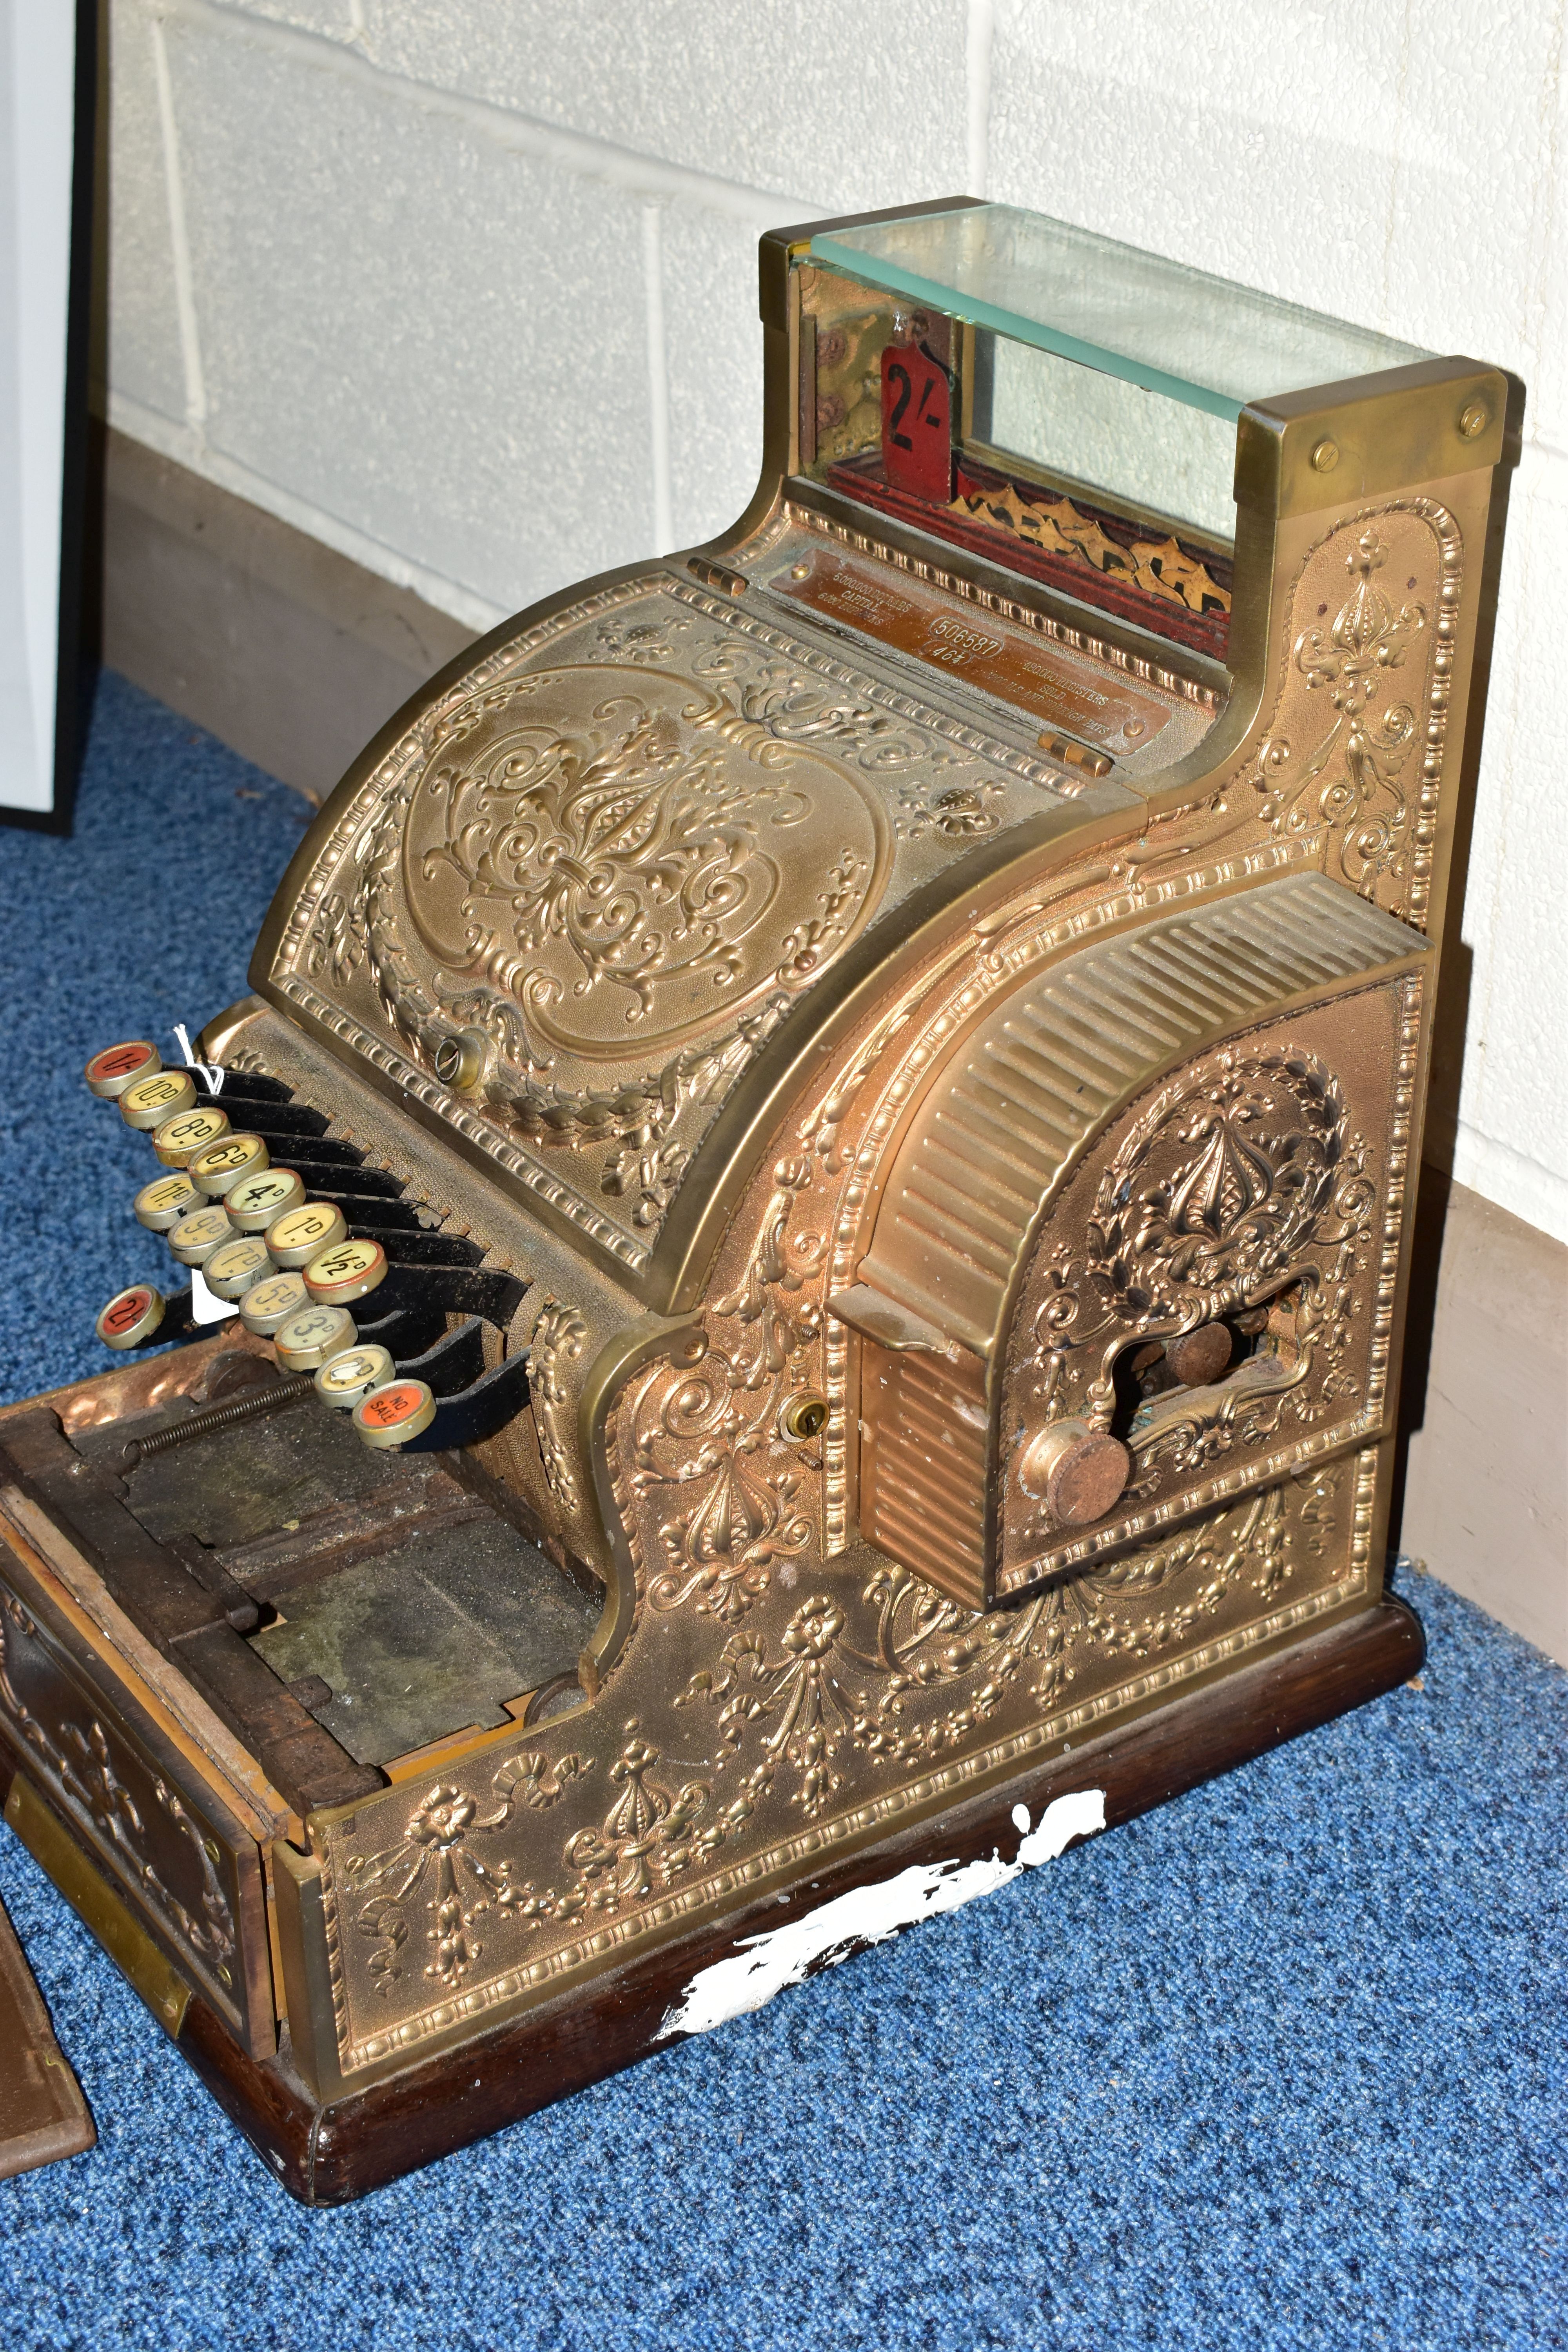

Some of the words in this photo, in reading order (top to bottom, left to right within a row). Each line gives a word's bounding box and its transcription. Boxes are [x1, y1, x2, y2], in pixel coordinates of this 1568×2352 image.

[888, 364, 940, 452] 2/-
[841, 590, 879, 612] CAPITAL
[870, 589, 912, 612] DOLLARS
[935, 621, 998, 655] 506587
[1039, 684, 1066, 700] SOLD
[1055, 677, 1109, 706] REGISTERS
[1021, 690, 1044, 703] AND
[1045, 699, 1086, 722] FOREIGN
[370, 1401, 396, 1423] SALE
[390, 1396, 408, 1410] NO
